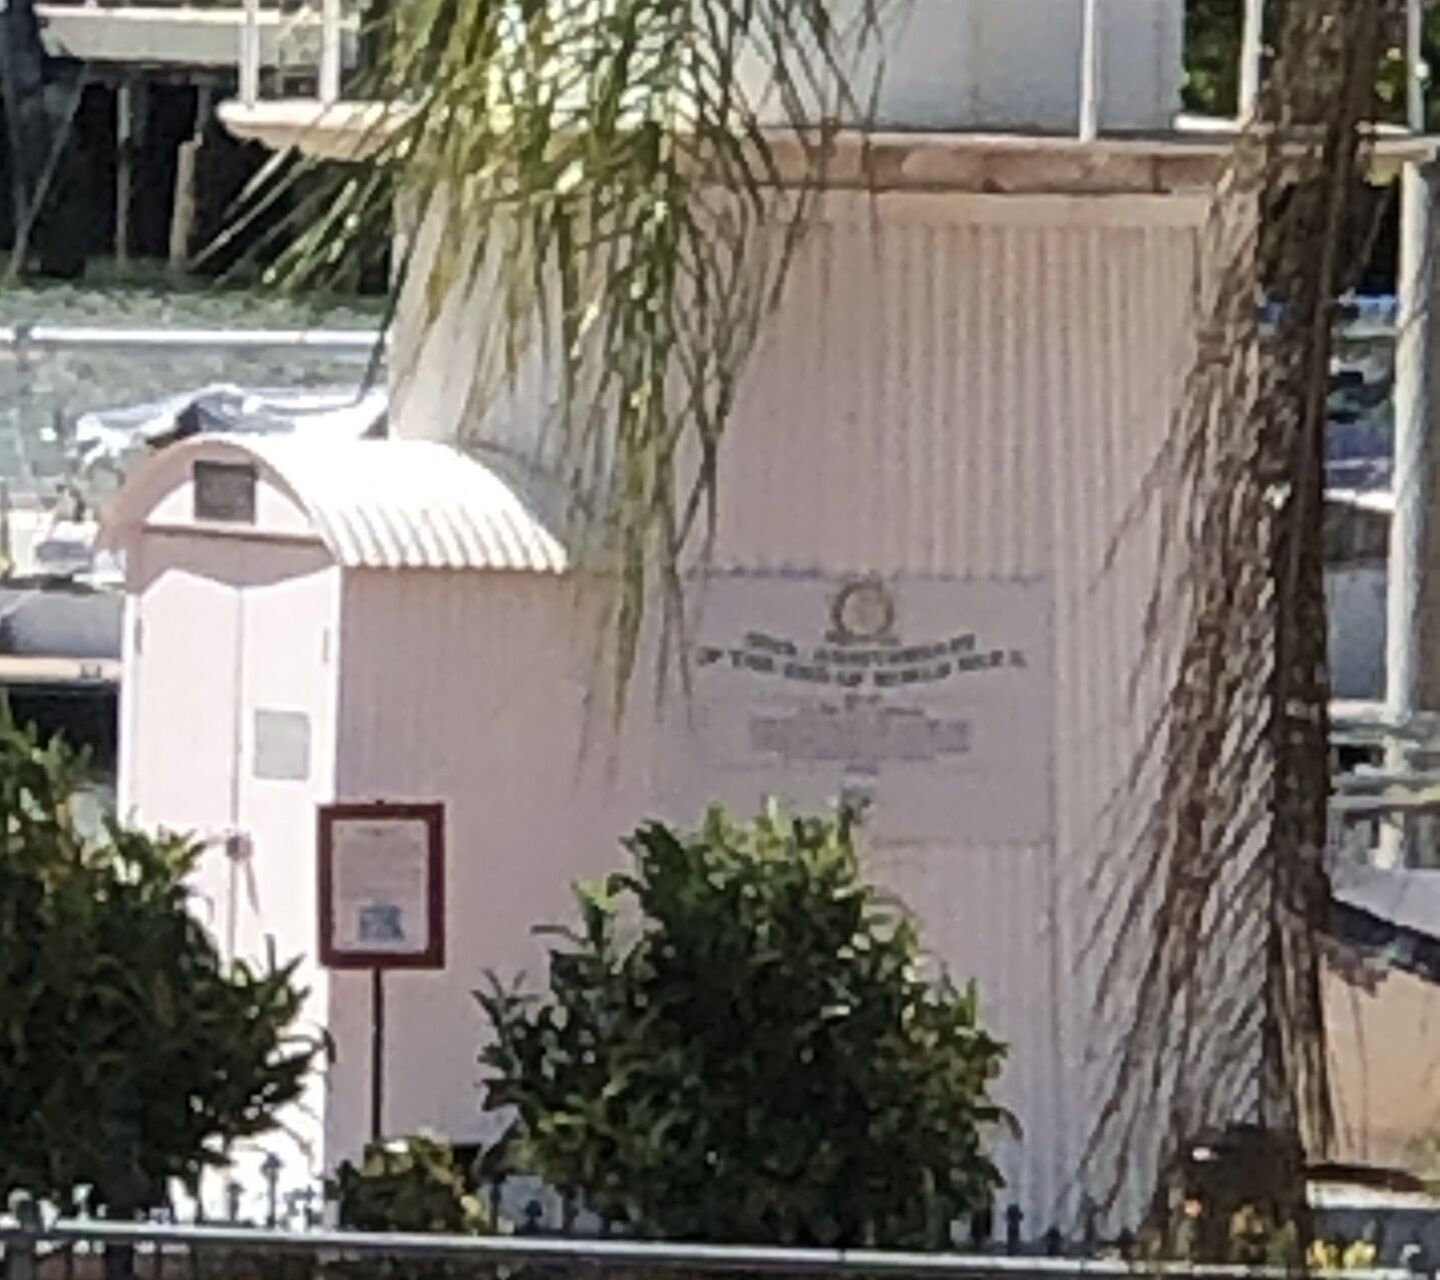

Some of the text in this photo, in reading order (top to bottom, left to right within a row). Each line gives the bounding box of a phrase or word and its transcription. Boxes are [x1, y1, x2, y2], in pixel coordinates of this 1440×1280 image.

[729, 649, 774, 673] THE
[836, 670, 863, 686] OF
[873, 662, 951, 687] WORLD
